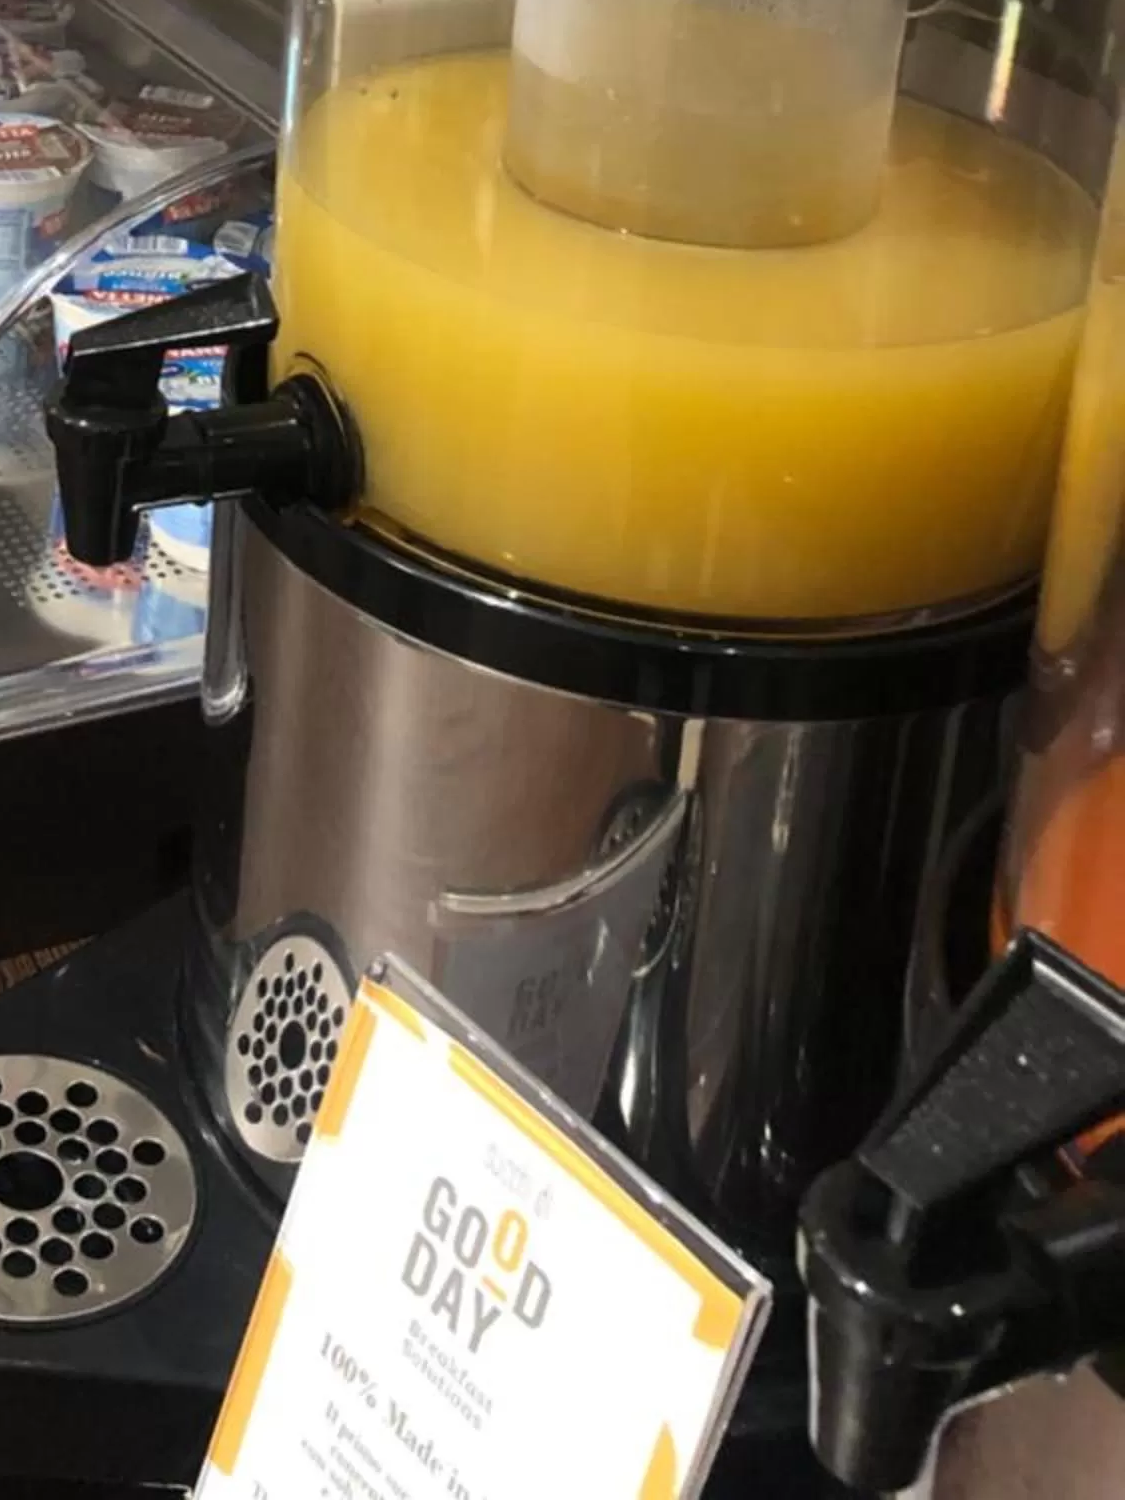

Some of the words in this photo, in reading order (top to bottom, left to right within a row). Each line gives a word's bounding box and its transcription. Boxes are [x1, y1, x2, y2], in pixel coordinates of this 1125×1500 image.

[400, 1230, 503, 1355] DAY
[422, 1175, 553, 1330] GOOD
[319, 1331, 379, 1409] 100%
[381, 1396, 444, 1477] Made
[401, 1337, 483, 1431] Solutions
[407, 1318, 493, 1416] Breakfast
